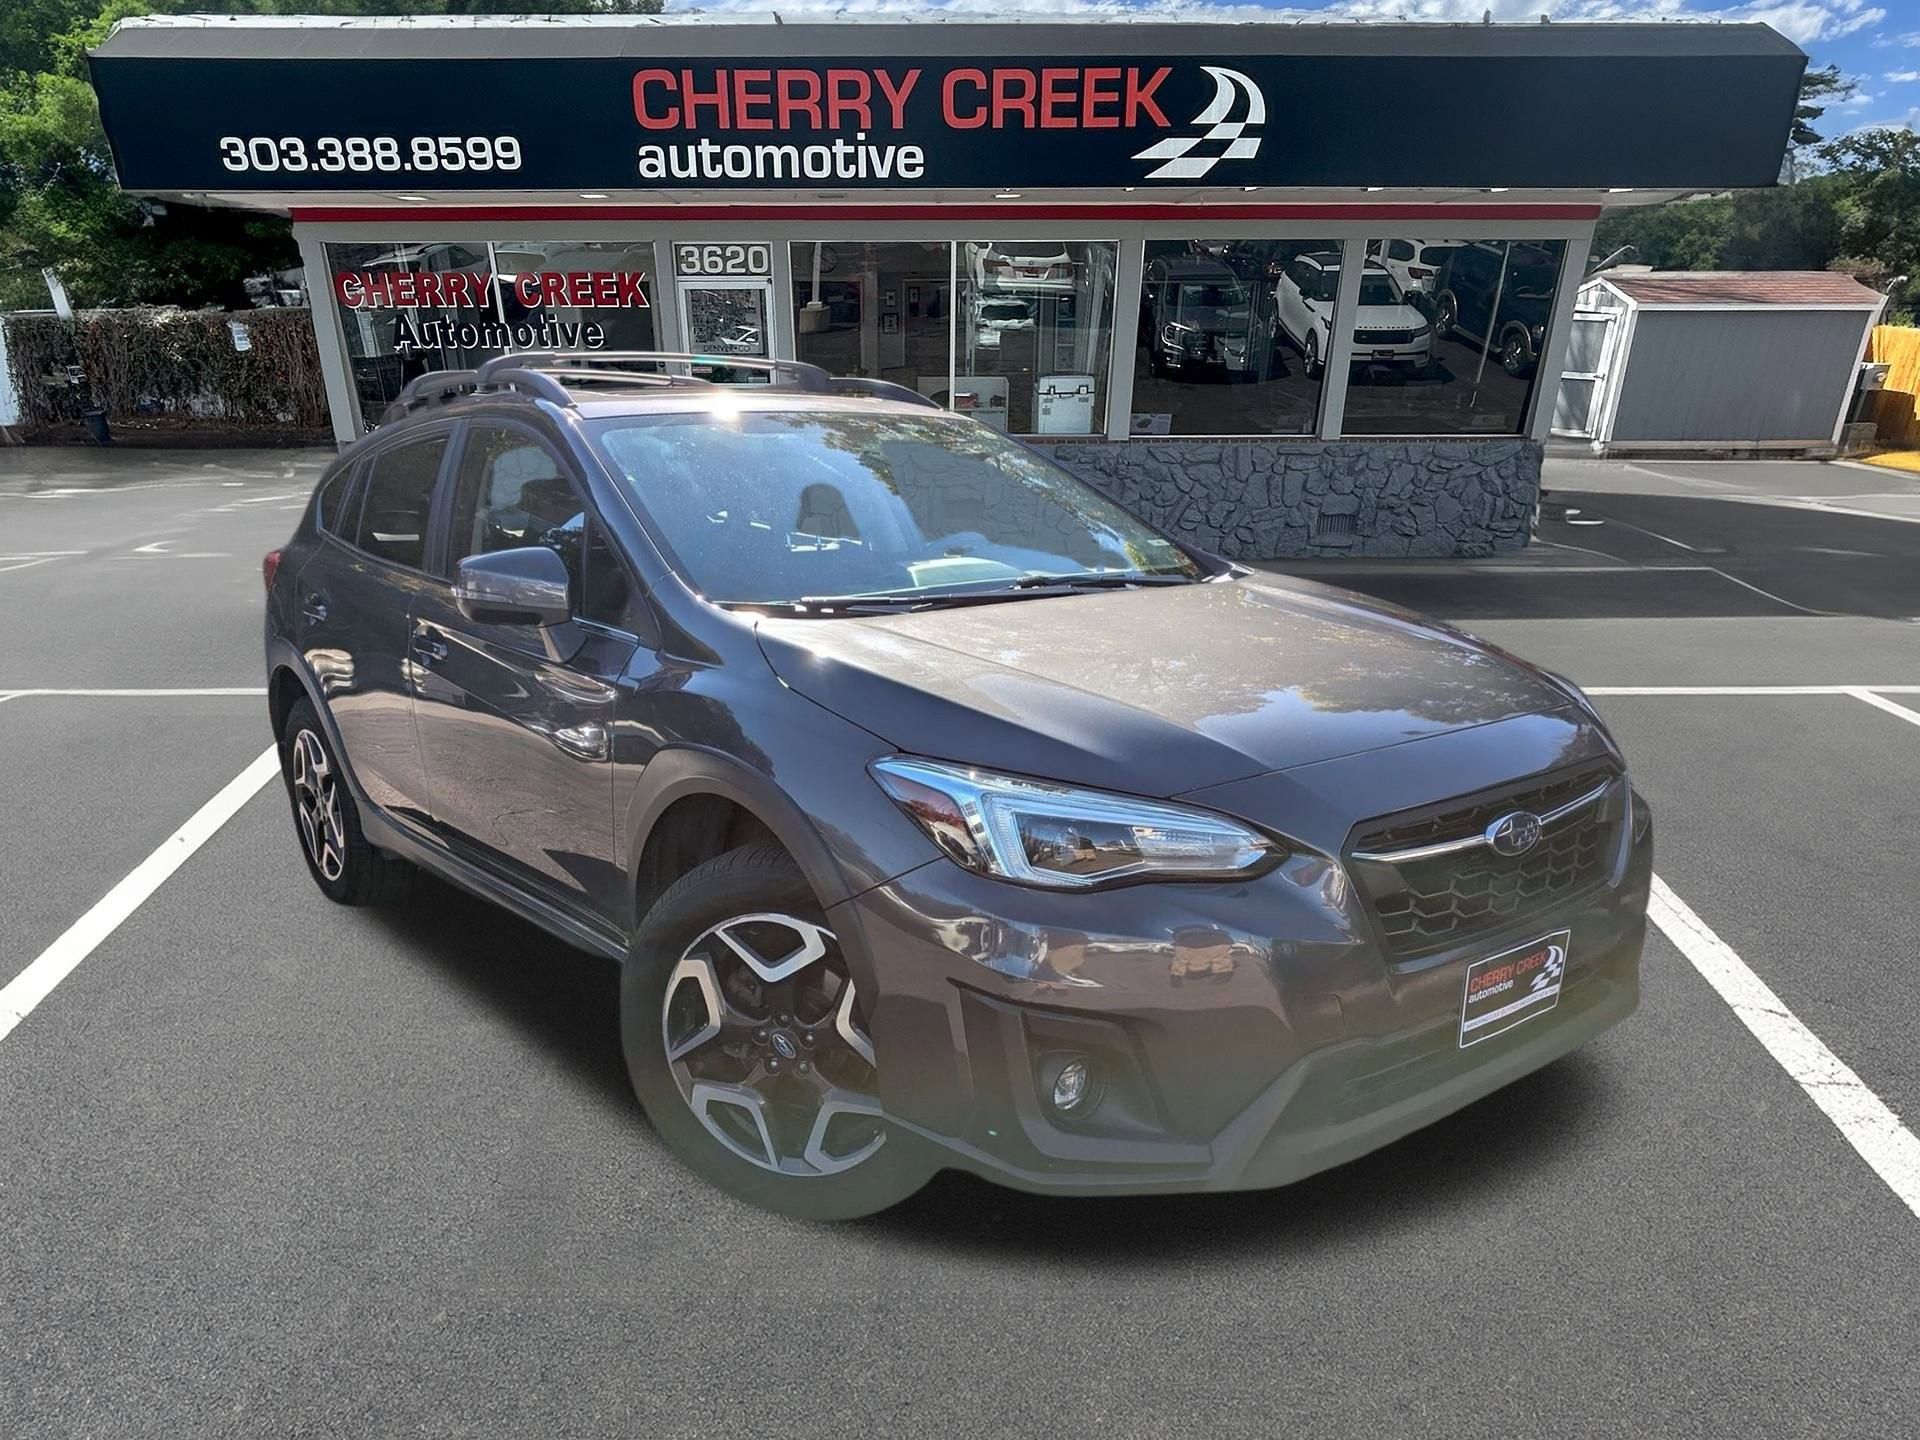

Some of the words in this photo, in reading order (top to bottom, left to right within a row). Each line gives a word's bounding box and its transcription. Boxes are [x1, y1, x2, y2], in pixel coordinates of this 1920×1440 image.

[632, 69, 922, 131] CHERRY
[941, 67, 1174, 128] CREEK
[219, 136, 522, 172] 303.388.8599
[638, 132, 925, 179] automotive
[680, 245, 769, 273] 3620
[334, 271, 494, 309] CHERRY
[514, 271, 651, 309] CREEK
[393, 313, 605, 350] Automotive
[1470, 965, 1514, 992] CHERRY
[1517, 949, 1547, 974] CREEK
[1468, 979, 1514, 1004] automotive
